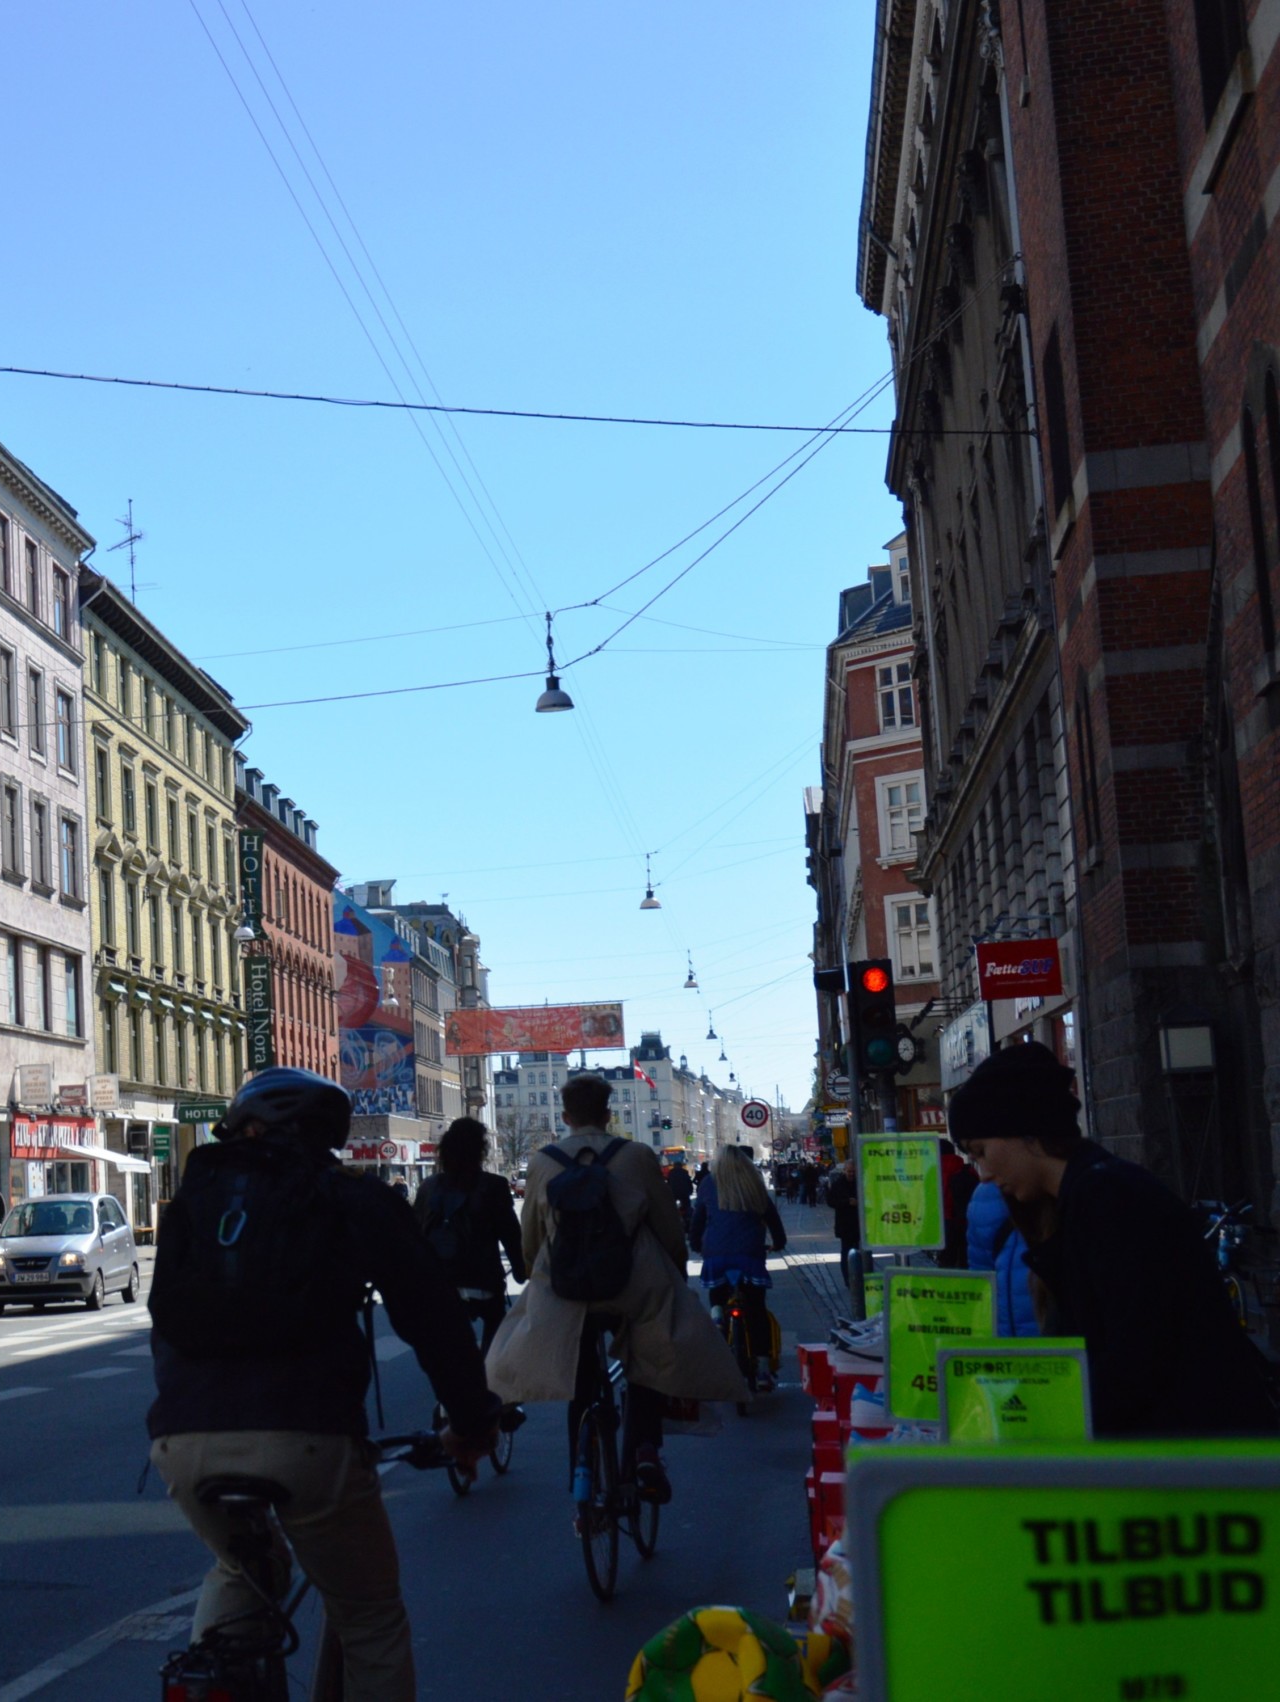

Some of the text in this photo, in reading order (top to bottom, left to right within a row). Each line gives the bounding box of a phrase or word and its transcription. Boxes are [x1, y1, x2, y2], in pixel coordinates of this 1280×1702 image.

[251, 963, 270, 1065] Hotel Nora
[185, 1108, 222, 1119] HOTEL
[746, 1110, 764, 1120] 40
[383, 1145, 395, 1154] 40
[1022, 1512, 1262, 1566] TILBUD
[1025, 1570, 1266, 1626] TILBUD
